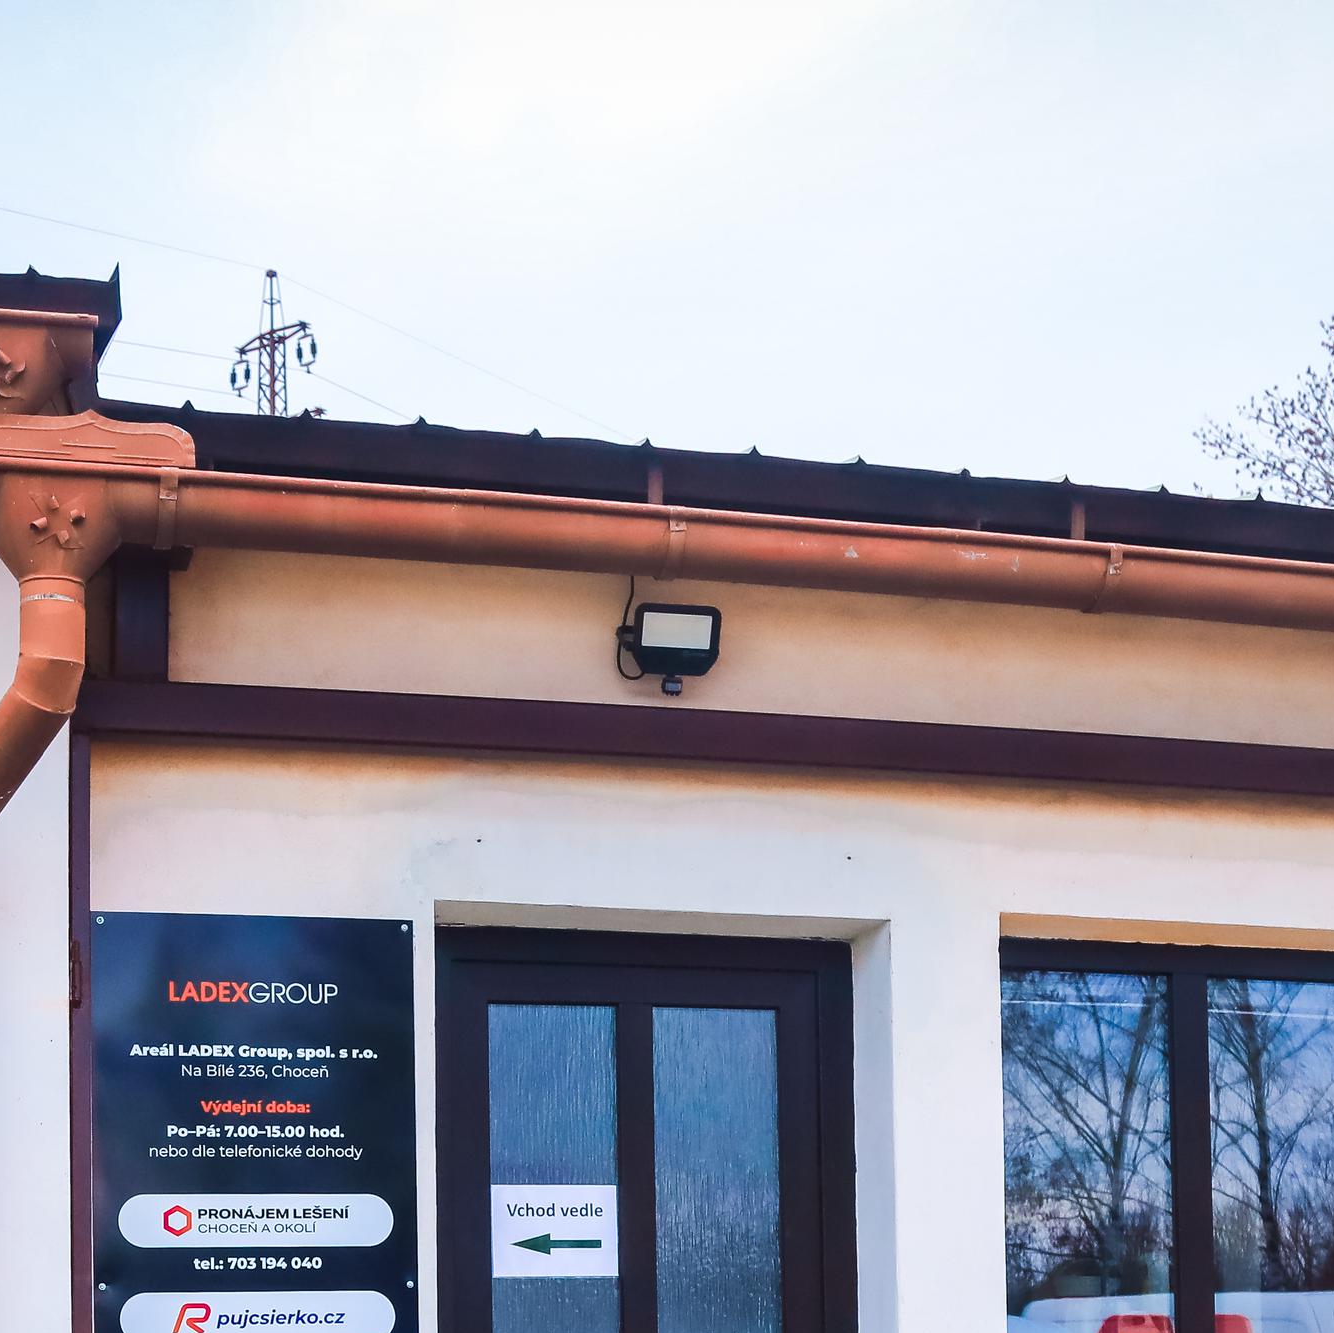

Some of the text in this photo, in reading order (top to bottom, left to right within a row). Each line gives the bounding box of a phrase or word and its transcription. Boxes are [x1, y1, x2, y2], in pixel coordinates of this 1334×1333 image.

[168, 981, 338, 1004] LADEXGROUP
[129, 1043, 378, 1061] Areál LADEX Group, spol. s r.o.
[181, 1064, 329, 1079] Na Bílé 236, Choceň
[200, 1100, 310, 1115] Výdejní doba:
[309, 1125, 345, 1139] hod.
[149, 1145, 363, 1160] nebo dle telefonické dohody
[197, 1205, 350, 1219] PRONÁJEM LEŠENÍ
[507, 1203, 603, 1217] Vchod vedle
[197, 1221, 317, 1234] CHOCEŇ A OKOLÍ
[193, 1257, 323, 1270] tel.: 703 194 040
[216, 1309, 345, 1329] pujcsierko.cz
